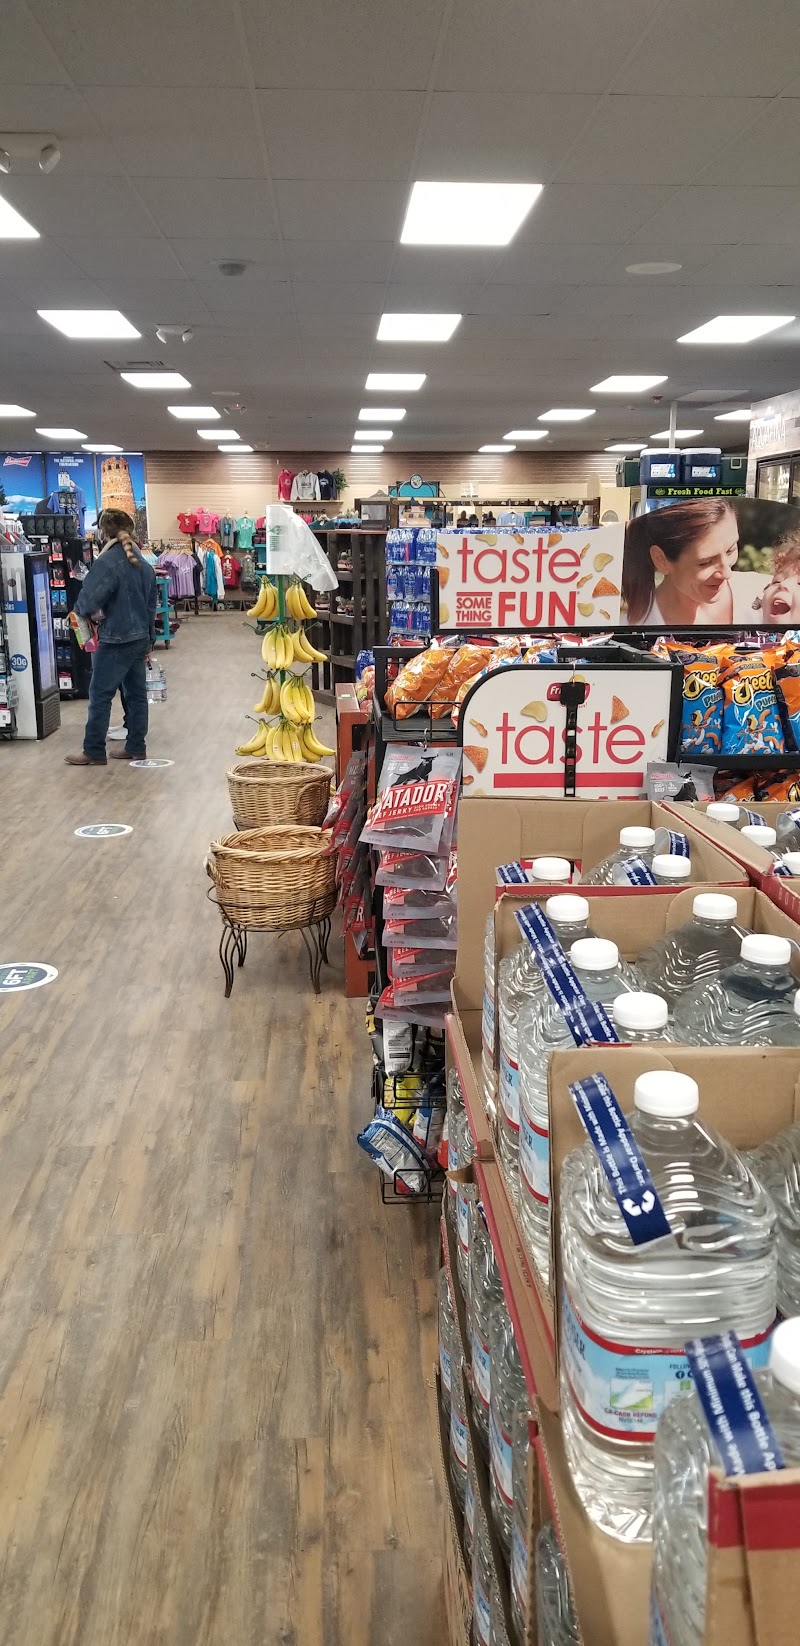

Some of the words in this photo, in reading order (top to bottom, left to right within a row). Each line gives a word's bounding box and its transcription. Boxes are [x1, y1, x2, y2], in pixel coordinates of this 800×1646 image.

[456, 537, 581, 584] taste
[456, 597, 492, 610] SOME
[498, 591, 576, 627] FUN
[456, 610, 492, 622] THING
[11, 657, 27, 666] 30G
[389, 807, 413, 817] JERKY
[3, 969, 28, 985] 6FT
[587, 1110, 599, 1127] with
[594, 1125, 607, 1147] Made
[607, 1106, 622, 1128] Bottle
[617, 1128, 635, 1156] Appear
[628, 1155, 646, 1186] Darker.
[602, 1145, 610, 1154] is
[605, 1152, 620, 1178] Bottle
[615, 1176, 628, 1195] This
[702, 1368, 725, 1415] Minimum
[730, 1361, 747, 1389] Make
[740, 1387, 756, 1412] this
[748, 1411, 770, 1450] Bottle
[717, 1415, 734, 1443] with
